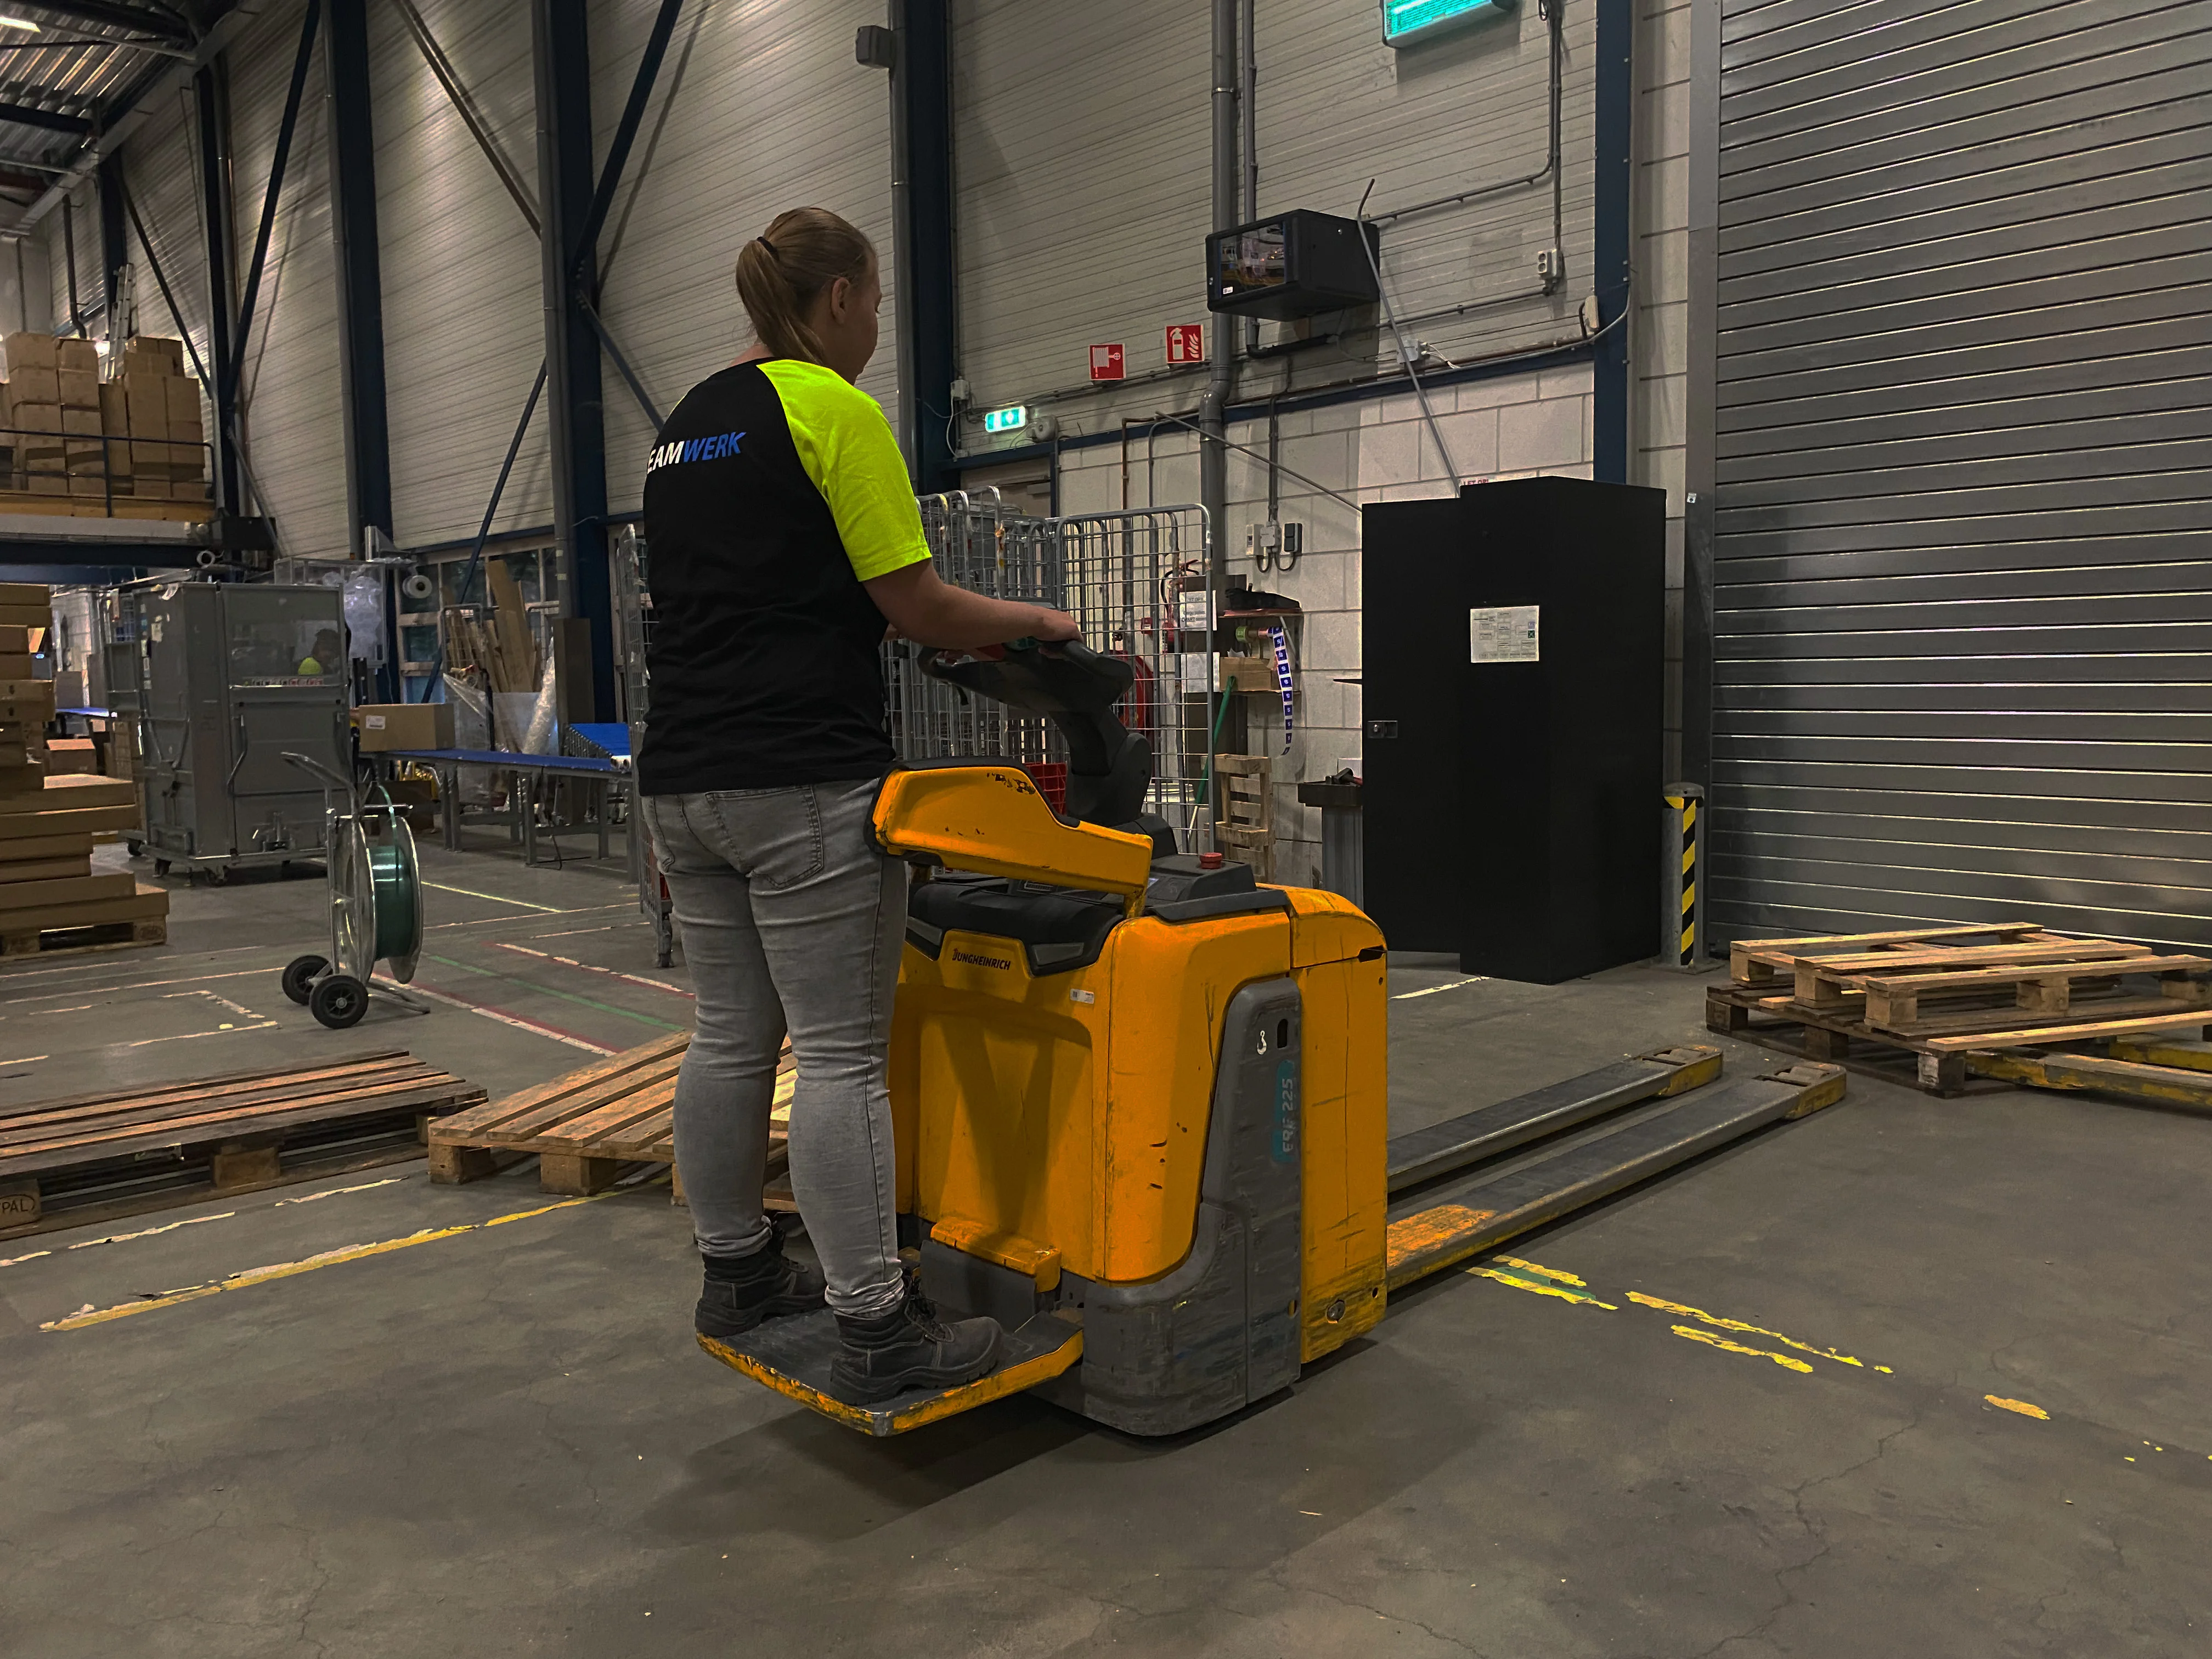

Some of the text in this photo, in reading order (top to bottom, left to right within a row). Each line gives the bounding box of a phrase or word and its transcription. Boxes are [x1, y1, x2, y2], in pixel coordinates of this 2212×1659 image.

[647, 431, 747, 475] EAMWERK
[952, 948, 1011, 970] JUNGHEINRICH
[1282, 1078, 1293, 1111] 225
[0, 1198, 28, 1214] PAL
